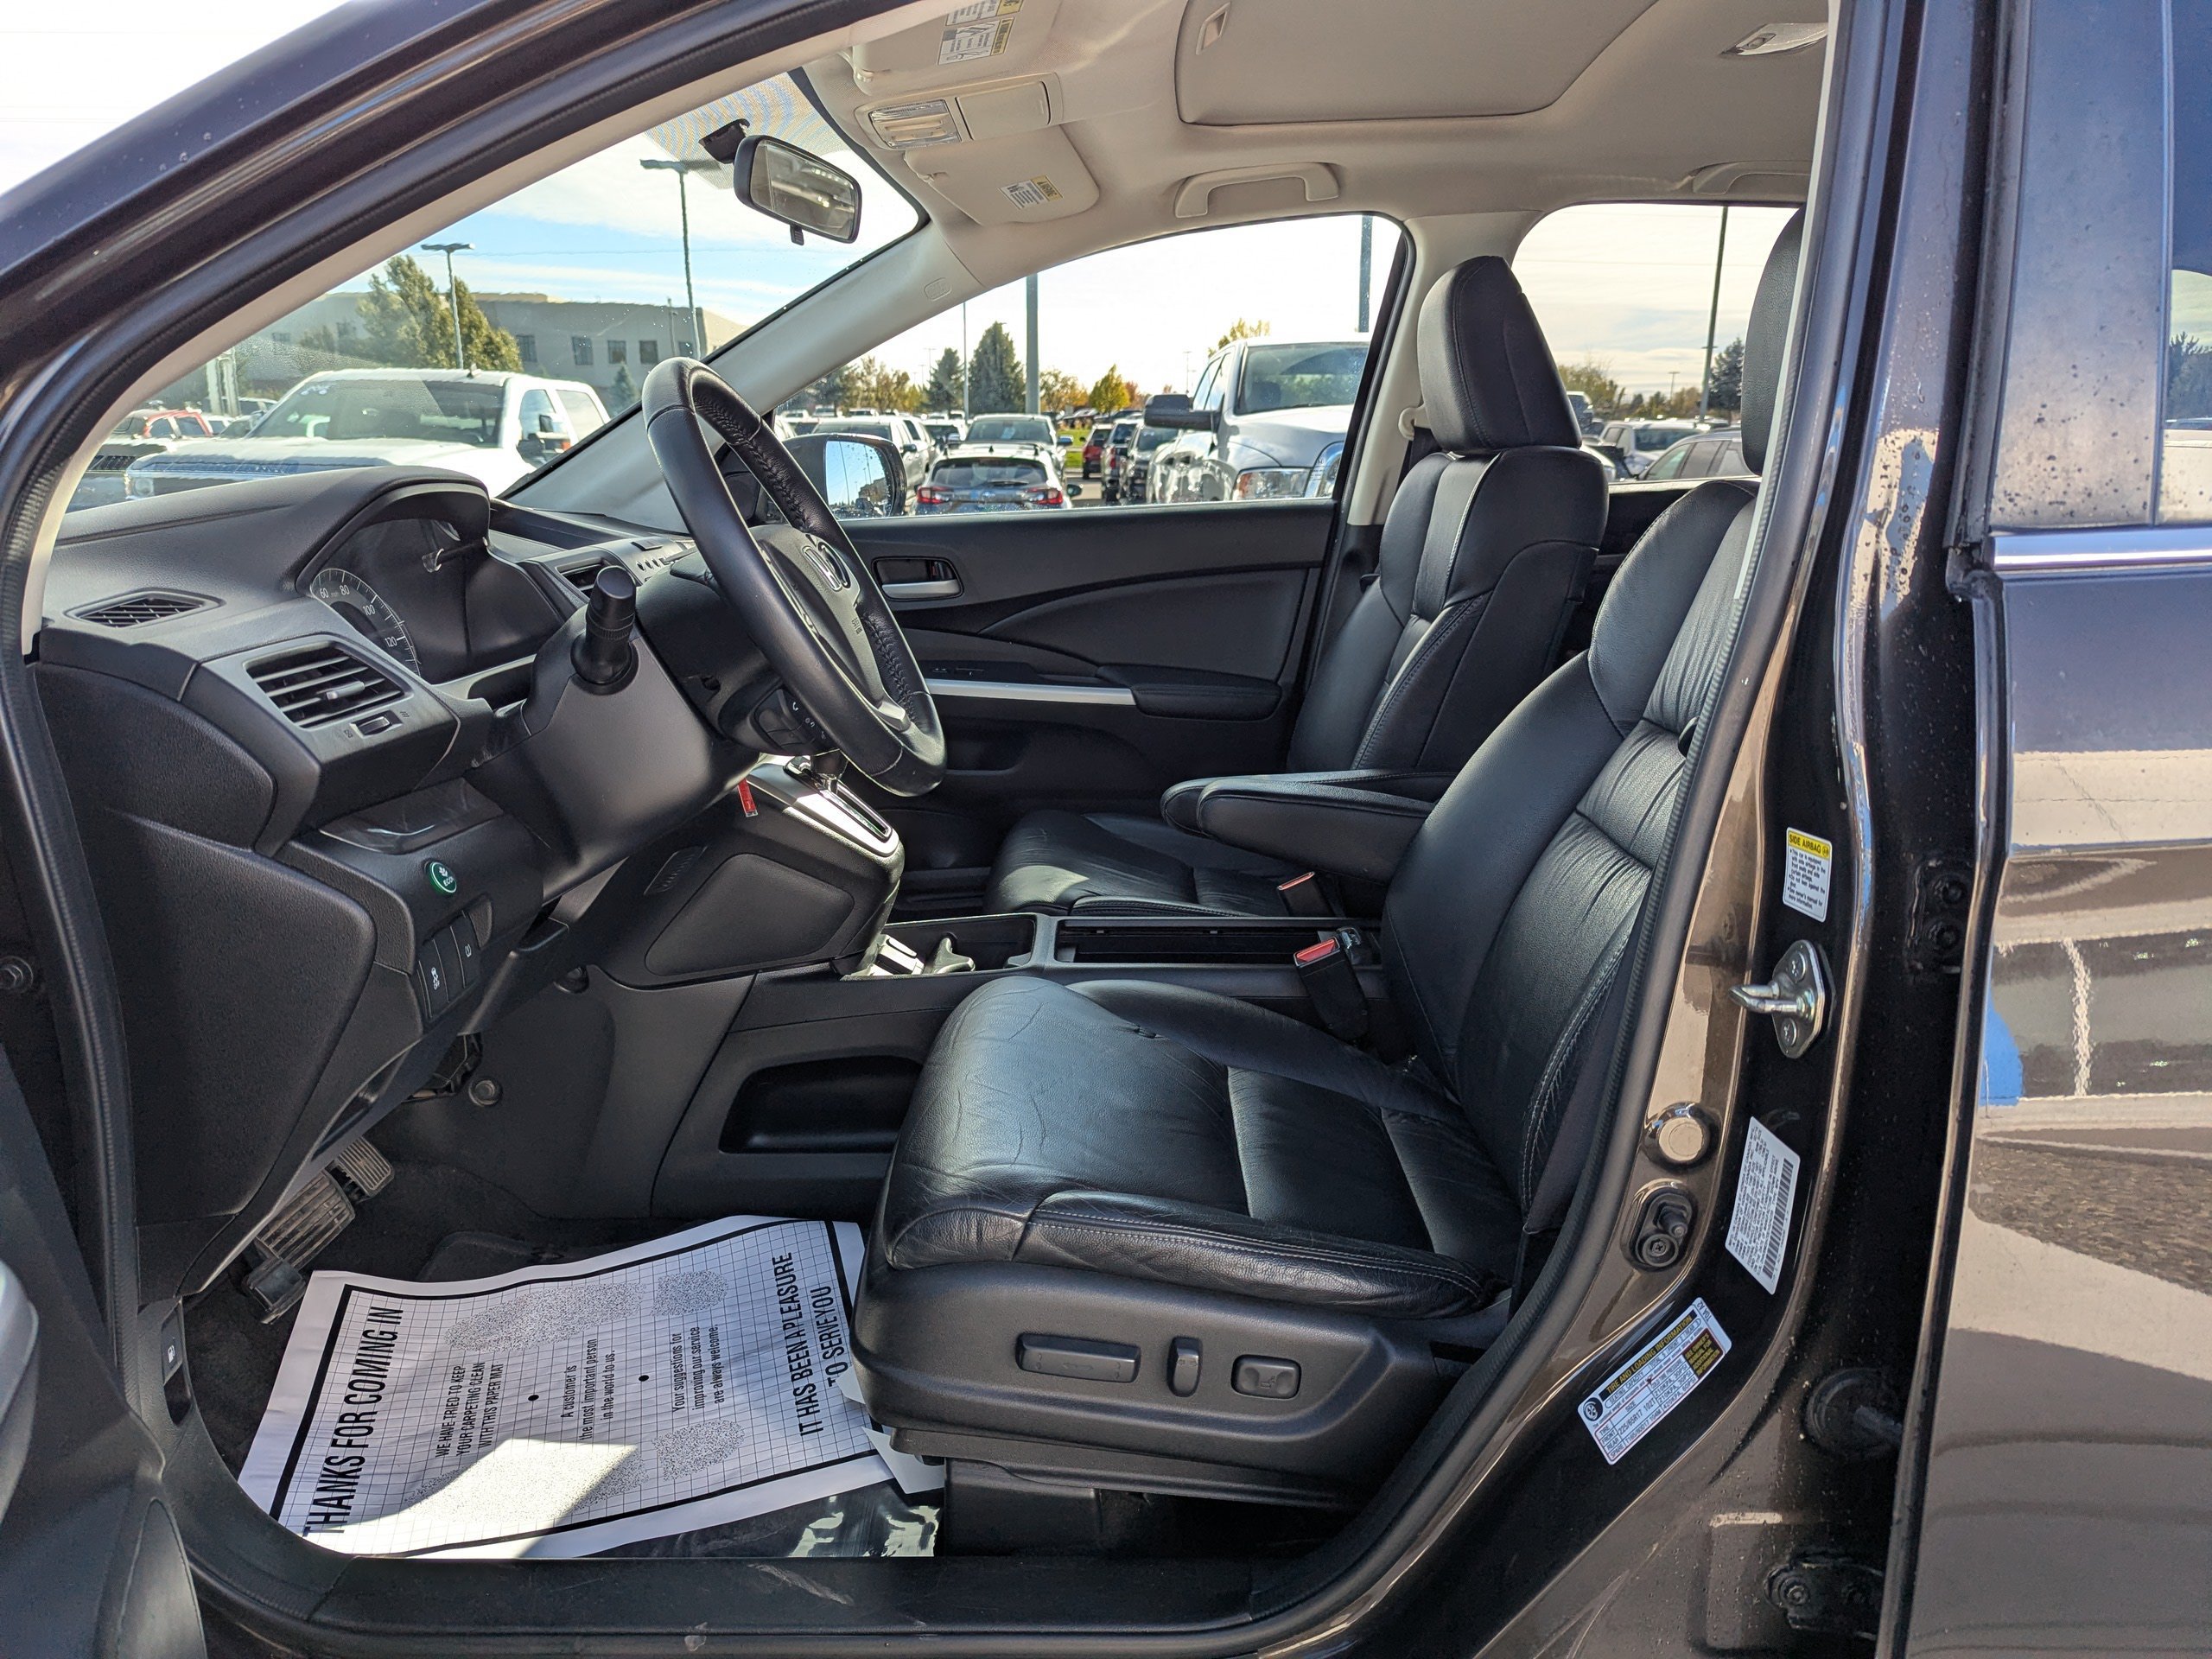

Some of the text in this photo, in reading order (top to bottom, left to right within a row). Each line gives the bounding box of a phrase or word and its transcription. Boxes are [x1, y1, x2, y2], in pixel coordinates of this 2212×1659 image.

[320, 588, 329, 599] 60
[339, 585, 350, 595] 80
[363, 604, 376, 616] 100
[385, 636, 397, 647] 120
[1789, 835, 1801, 846] SIDE
[1802, 838, 1821, 852] AIRBAG
[810, 1286, 836, 1317] YOU
[772, 1252, 823, 1436] IT HAS BEEN A PLEASURE
[816, 1316, 845, 1361] SERVE
[1606, 1379, 1620, 1393] TIRE
[1618, 1369, 1632, 1382] AND
[1630, 1348, 1656, 1372] LOADING
[1654, 1314, 1693, 1351] INFORMATION
[601, 1351, 615, 1421] in the world to us.
[670, 1333, 686, 1412] Your suggestions for
[688, 1327, 708, 1410] improving our service
[710, 1362, 724, 1389] always
[1625, 1370, 1644, 1389] CAPACITY
[478, 1363, 504, 1449] WITH THIS PAPER MAT
[563, 1375, 576, 1410] customer
[579, 1338, 599, 1440] the most important person
[714, 1389, 725, 1404] are
[1643, 1397, 1656, 1411] 102T
[303, 1306, 404, 1537] THANKS FOR COMING IN
[435, 1366, 466, 1457] WE HAVE TRIED TO KEEP
[456, 1362, 486, 1456] YOUR CARPETING CLEAN
[1599, 1424, 1609, 1435] TIRE
[1624, 1401, 1636, 1412] SIZE
